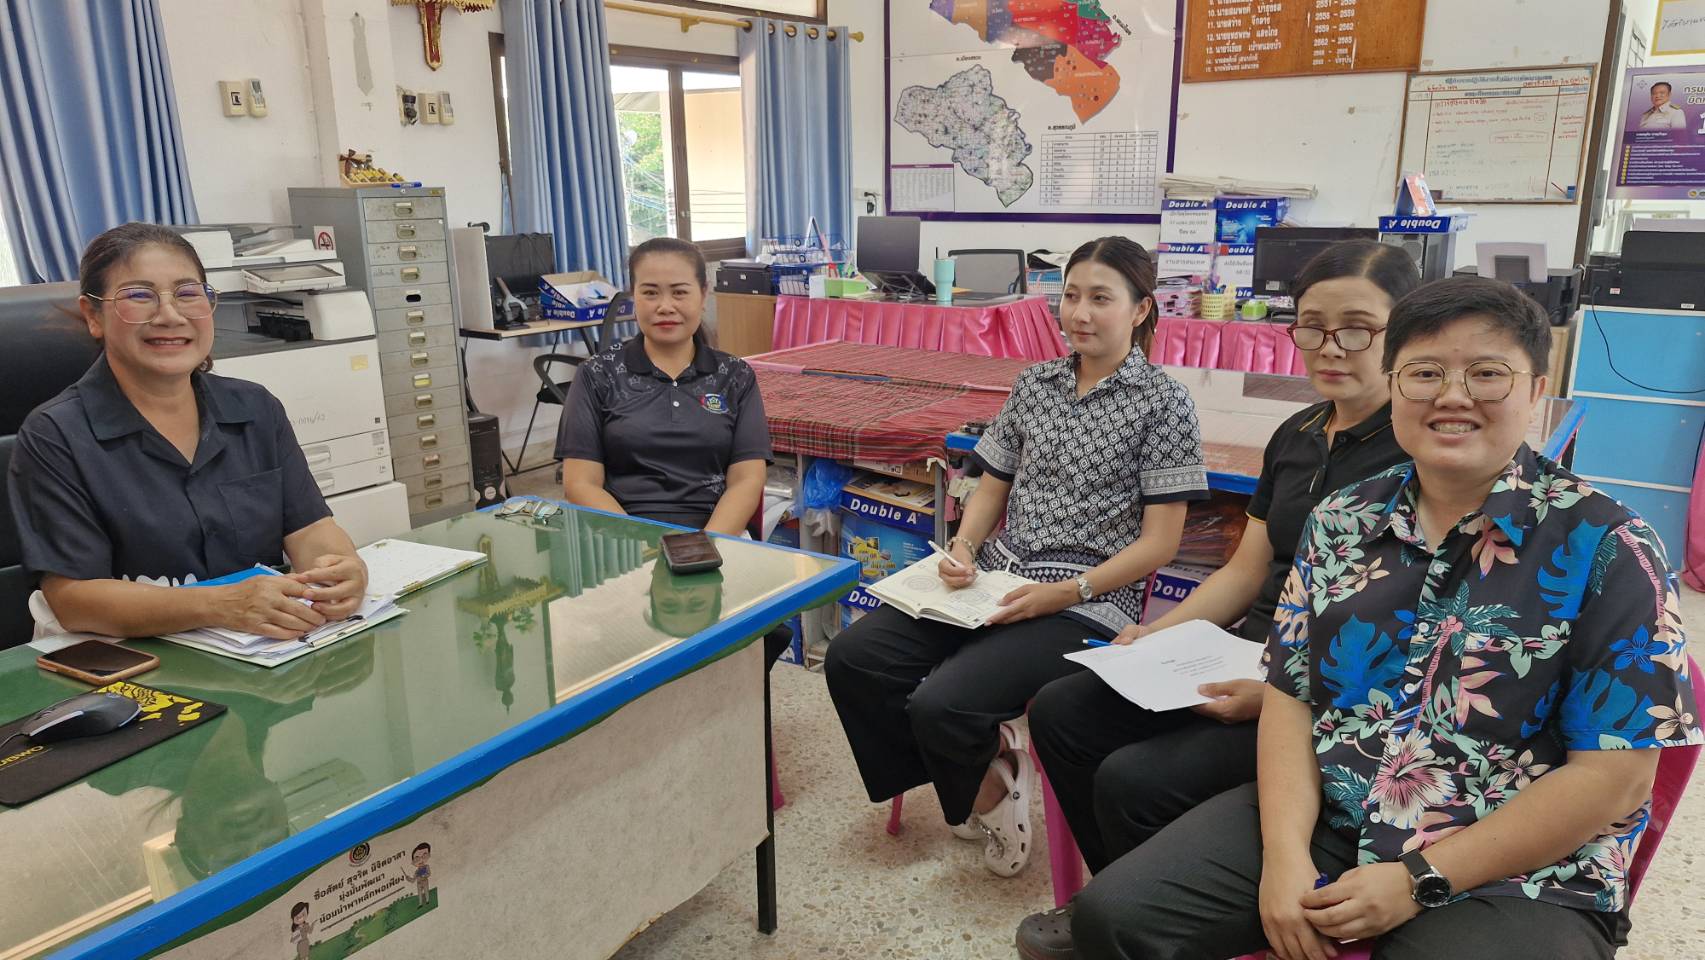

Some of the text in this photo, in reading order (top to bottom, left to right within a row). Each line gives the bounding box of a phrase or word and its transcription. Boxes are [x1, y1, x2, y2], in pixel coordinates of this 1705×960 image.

[1389, 219, 1441, 229] Double A
[850, 498, 917, 525] Double A
[313, 850, 406, 901] ซื่อสัตย์ สุจริต มีจิตอาสา
[338, 873, 386, 903] มุ่งมั่นพัฒนา
[319, 875, 405, 924] น้อมนำพาหลักพอเพียง
